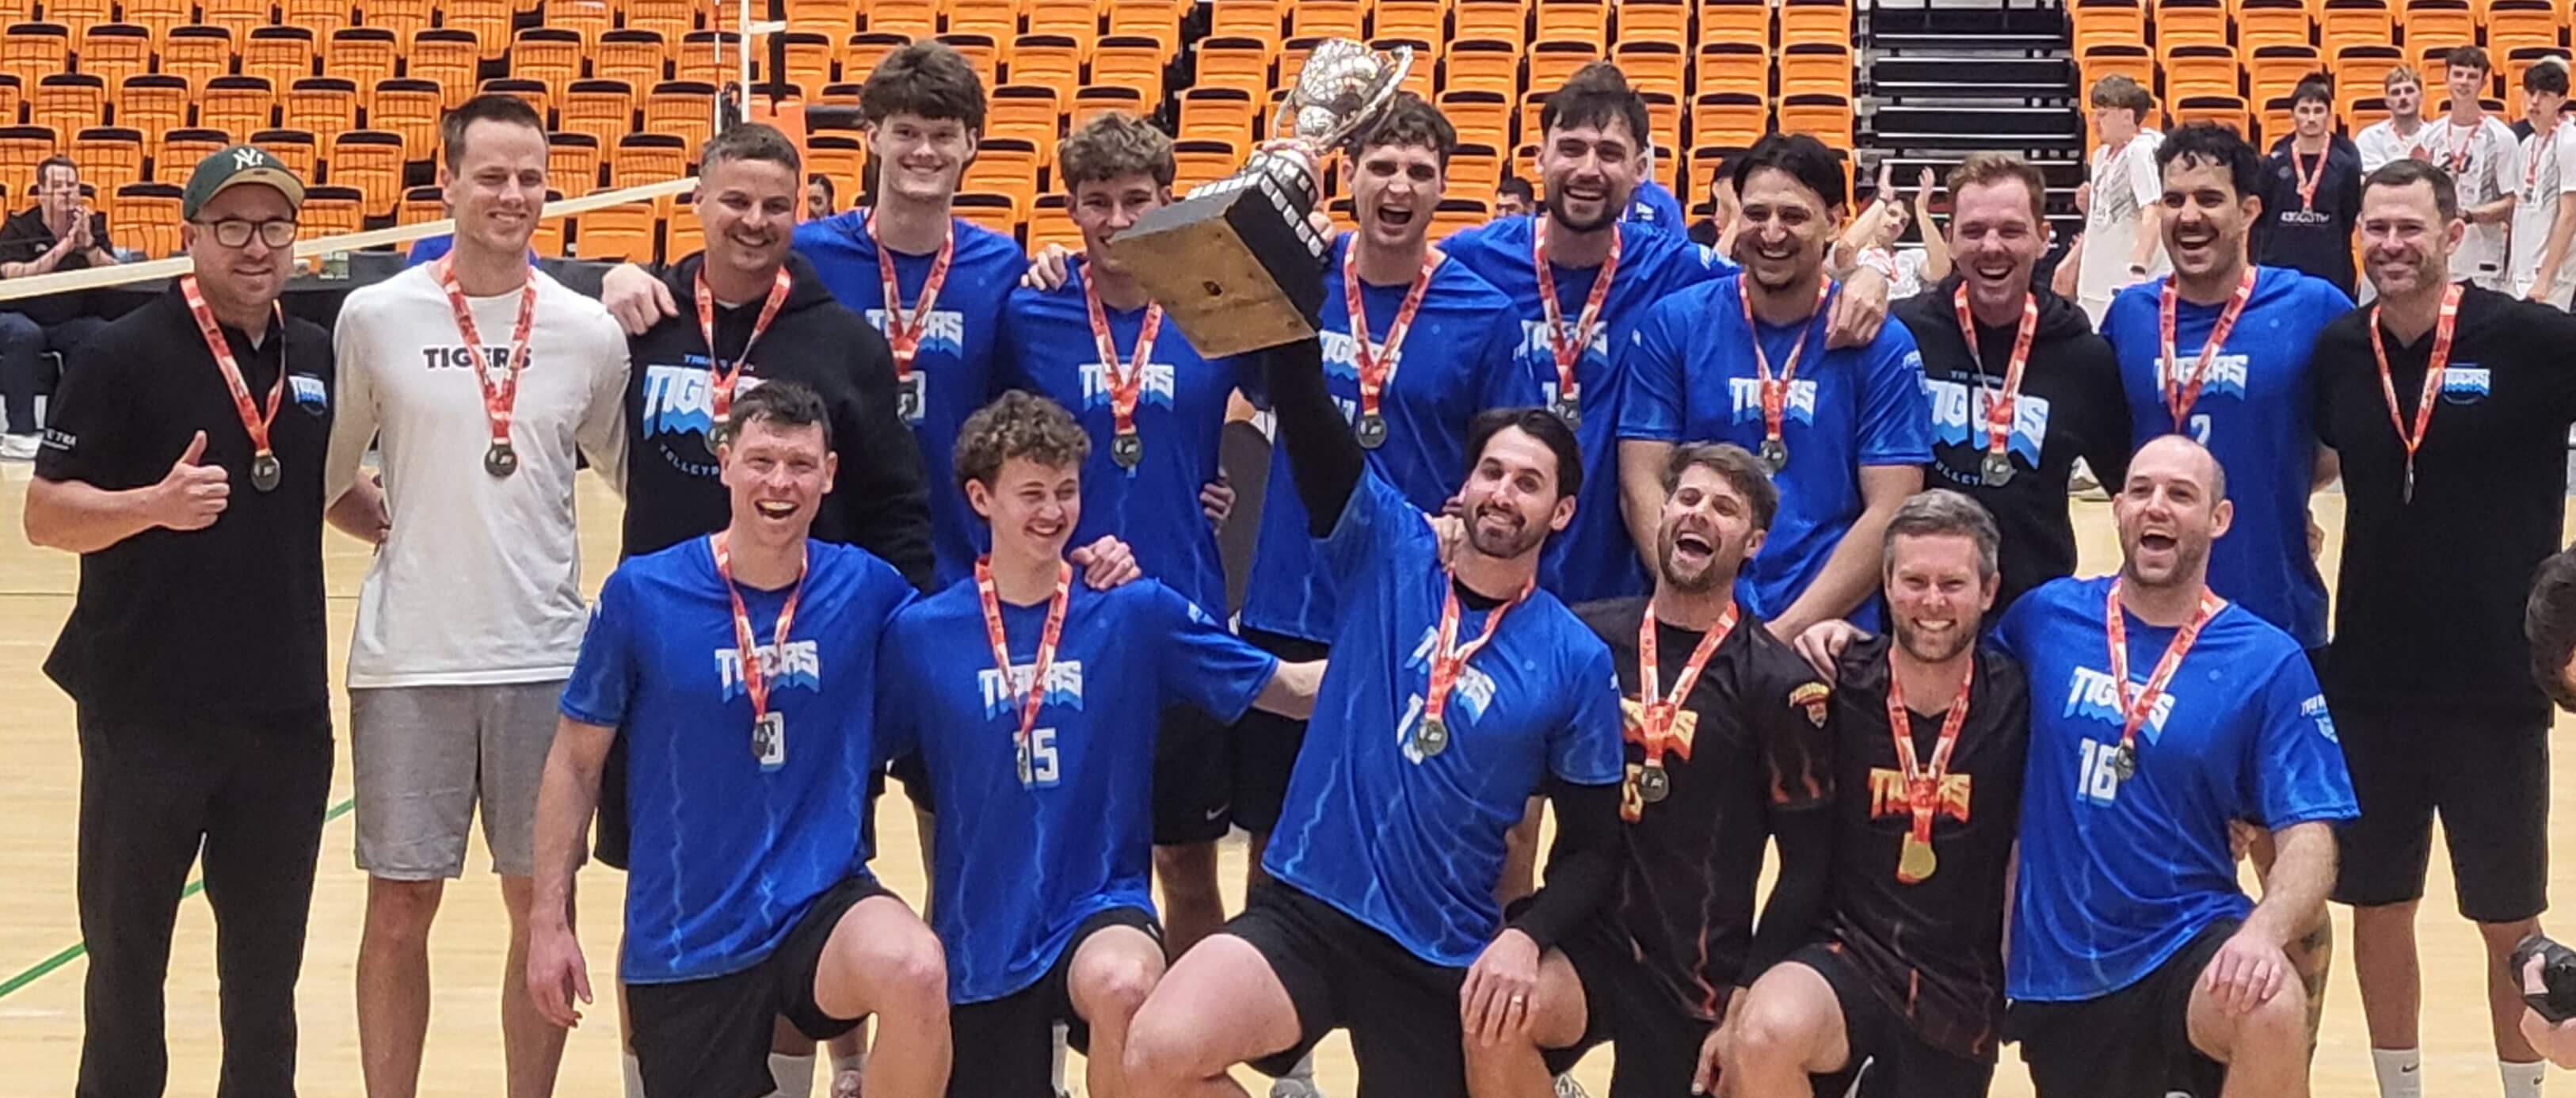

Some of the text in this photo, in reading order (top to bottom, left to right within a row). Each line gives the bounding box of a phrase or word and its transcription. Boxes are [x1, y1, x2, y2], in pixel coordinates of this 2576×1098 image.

[642, 364, 768, 440] TIG
[1078, 363, 1175, 412] TIRS
[1728, 376, 1817, 429] TIRS
[2153, 354, 2249, 404] TGRS
[660, 443, 720, 477] VOLLEYB
[714, 639, 821, 704] TIRS
[2063, 665, 2176, 746] TIGS
[1869, 768, 1972, 822] TIRS
